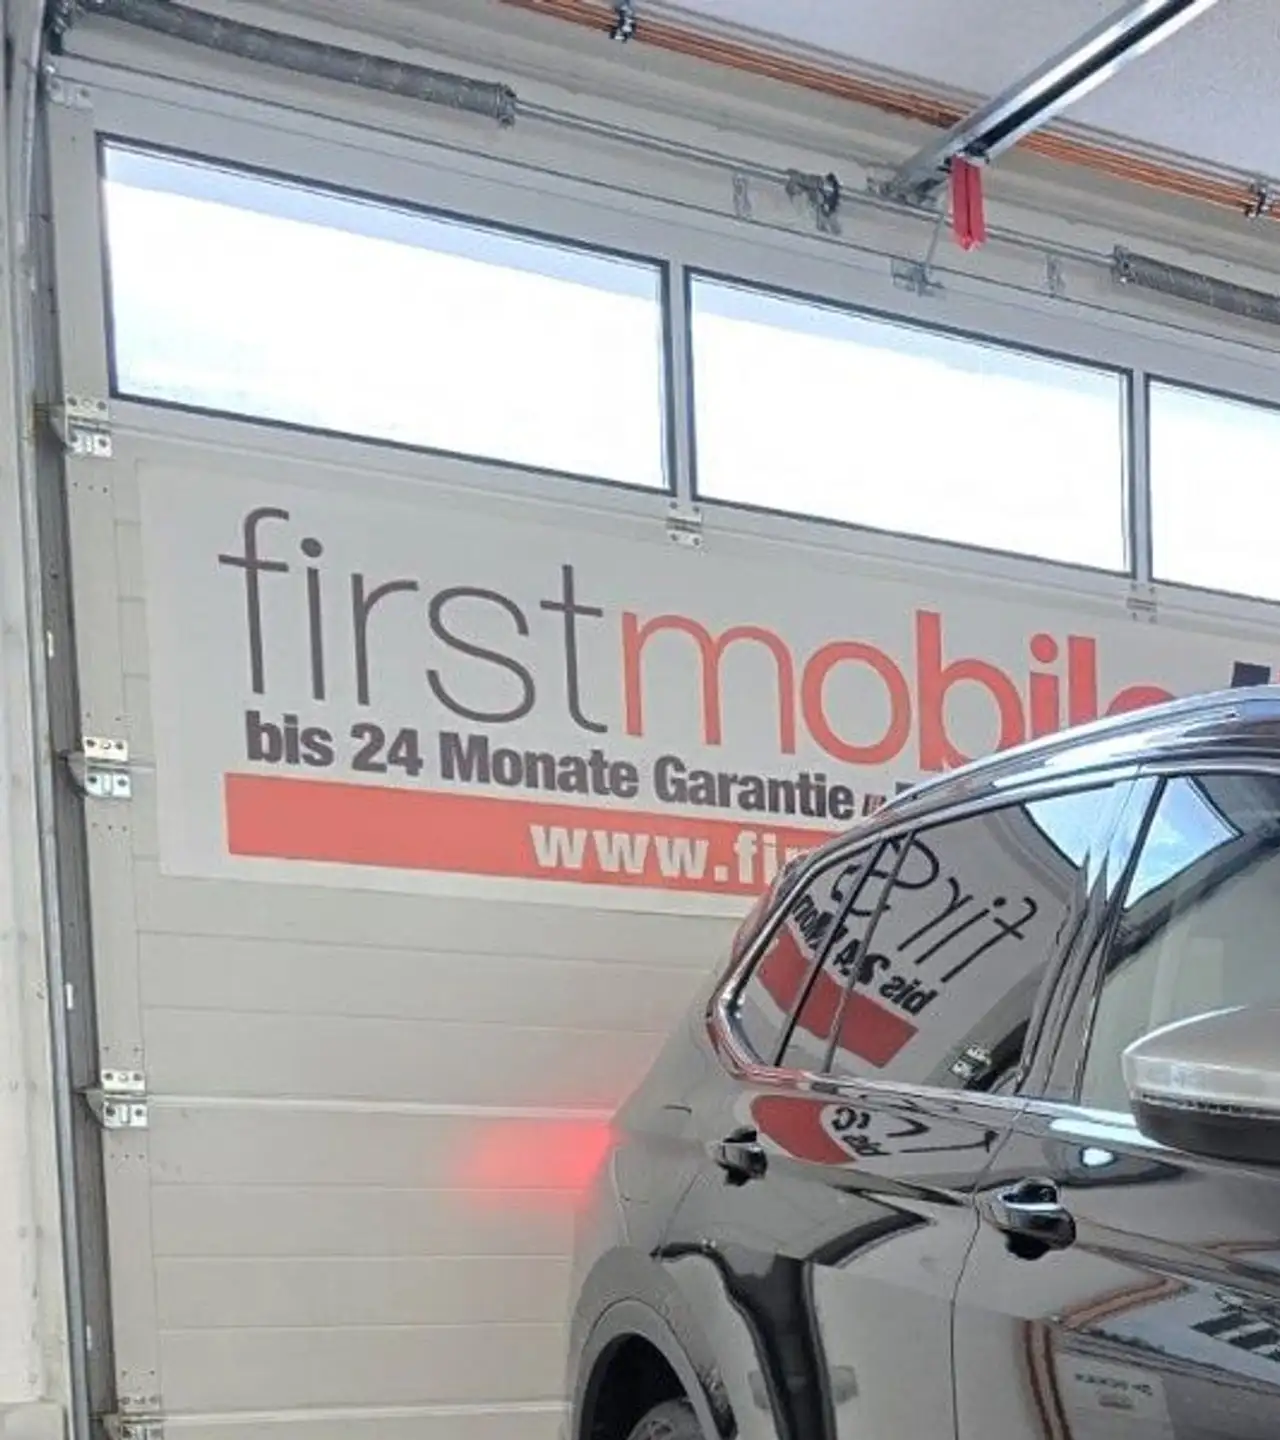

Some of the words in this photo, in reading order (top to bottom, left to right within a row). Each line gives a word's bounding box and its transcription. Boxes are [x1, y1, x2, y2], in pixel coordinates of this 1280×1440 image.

[245, 709, 335, 768] bis
[350, 721, 424, 777] 24
[438, 731, 640, 799] Monate
[653, 754, 855, 821] Garantie
